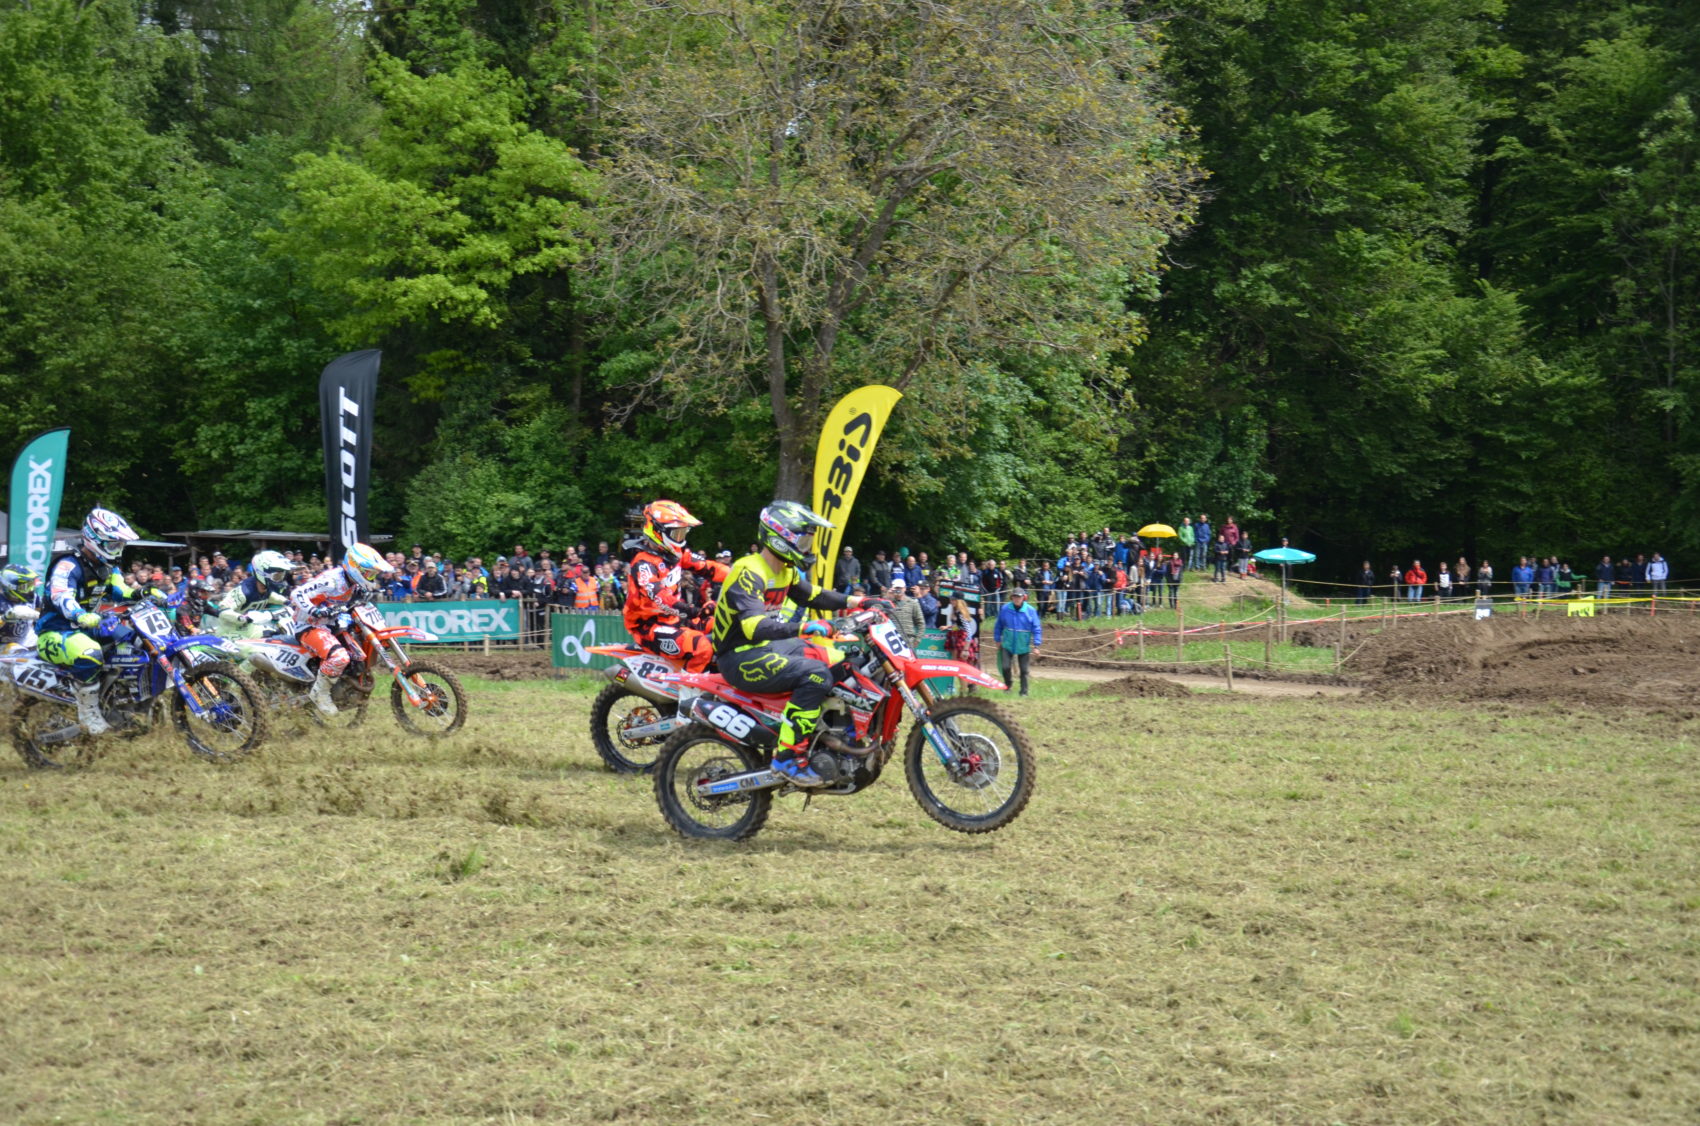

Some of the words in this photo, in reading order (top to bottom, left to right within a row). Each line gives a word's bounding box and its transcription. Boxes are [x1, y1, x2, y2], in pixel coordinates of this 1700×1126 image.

[339, 386, 359, 550] SCOTT
[815, 412, 872, 592] CERBiS
[144, 611, 169, 635] 15
[275, 650, 300, 667] 718
[17, 665, 53, 689] 15
[808, 673, 825, 685] FOX
[708, 704, 757, 739] 66
